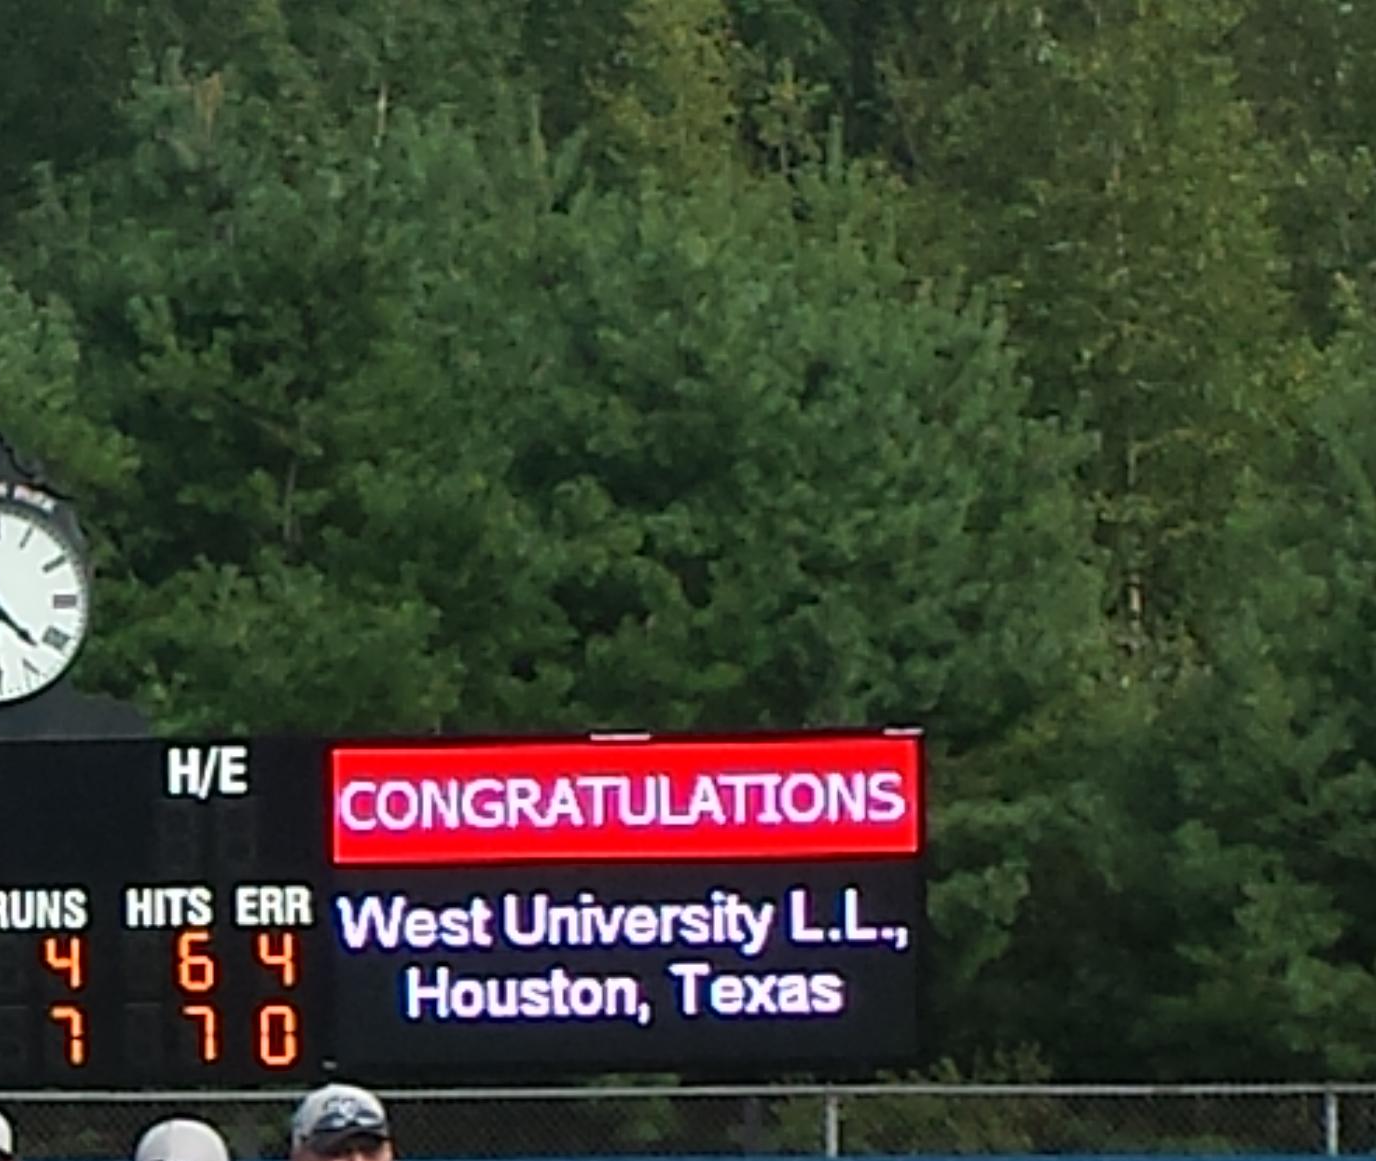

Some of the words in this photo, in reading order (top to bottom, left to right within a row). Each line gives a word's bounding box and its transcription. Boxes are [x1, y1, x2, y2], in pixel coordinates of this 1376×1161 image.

[168, 746, 248, 799] H/E
[338, 772, 906, 831] CONGRATULATIONS
[126, 887, 213, 927] HITS
[236, 885, 312, 926] ERR
[336, 896, 493, 948] West
[504, 890, 775, 955] University
[791, 888, 908, 949] L.L.,
[46, 938, 81, 988] 4
[179, 932, 214, 991] 6
[259, 933, 294, 986] 4
[407, 966, 650, 1024] Houston,
[669, 963, 843, 1015] Texas
[51, 1007, 83, 1064] 7
[184, 1005, 216, 1061] 7
[260, 1005, 296, 1065] 0
